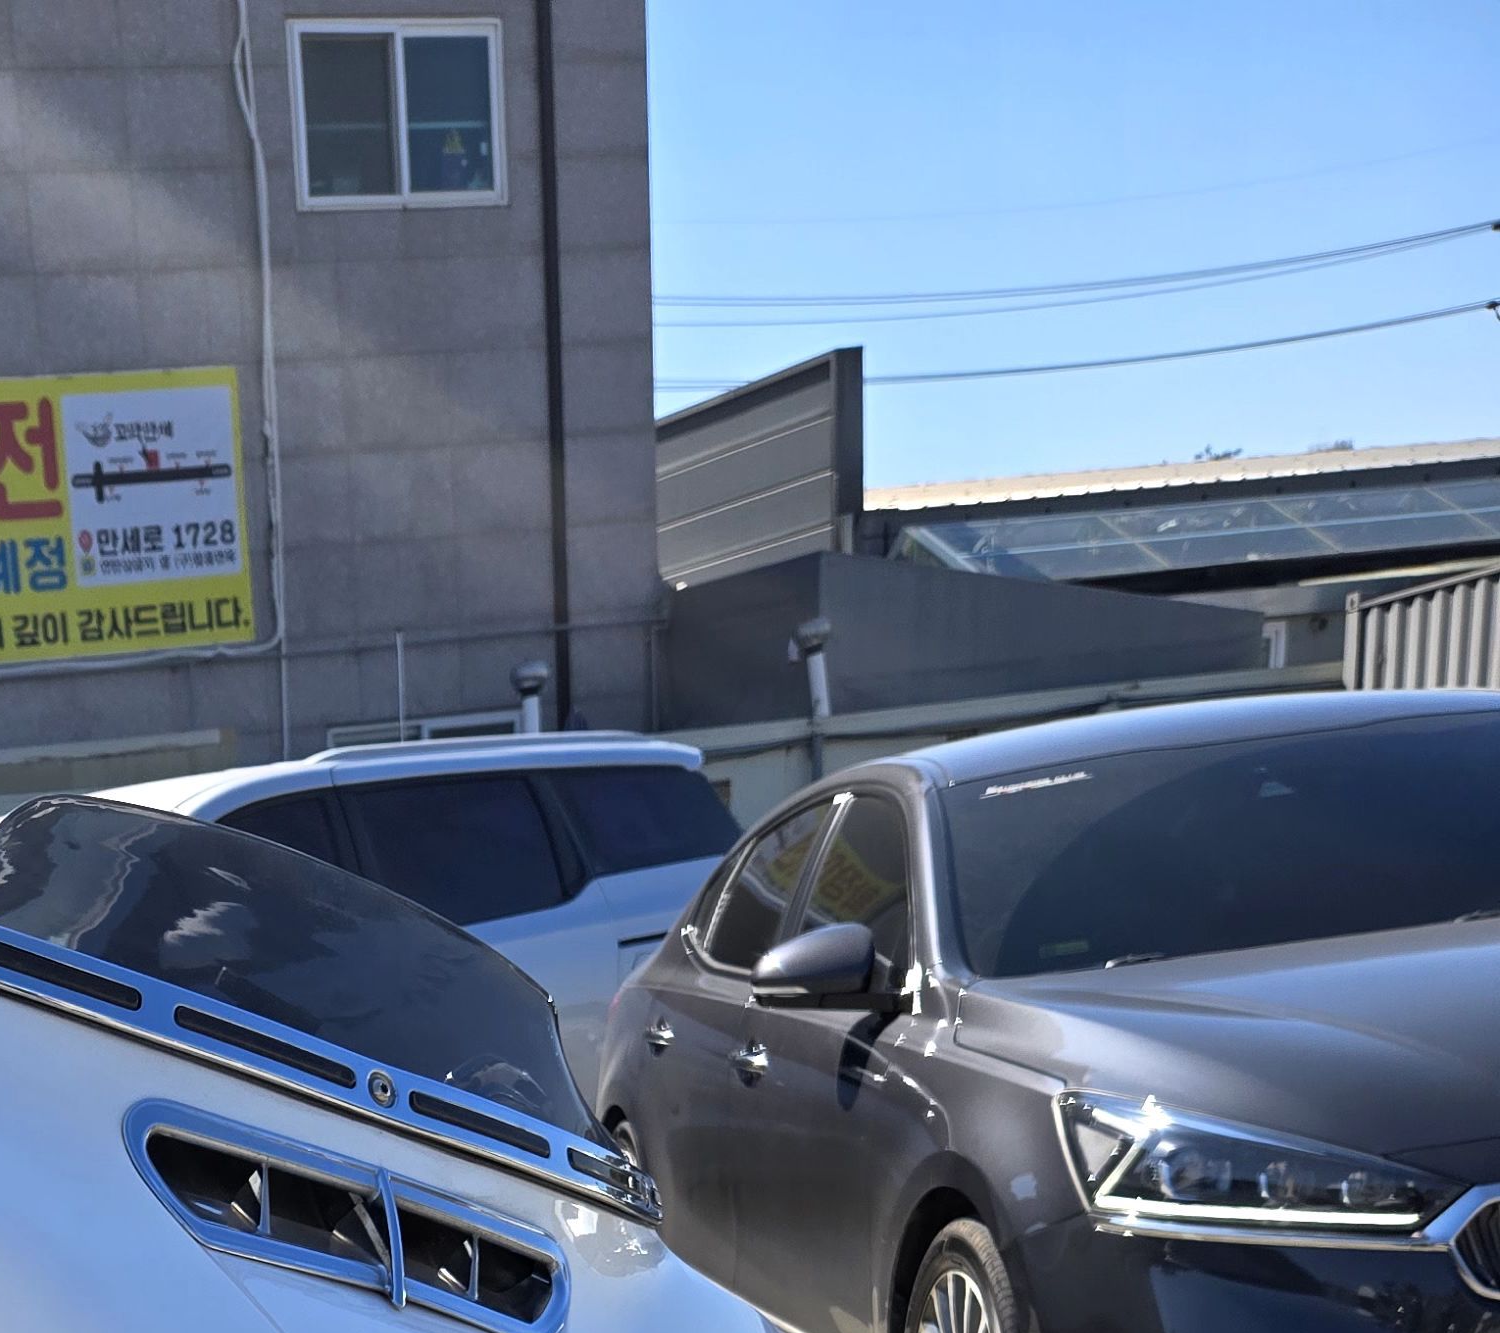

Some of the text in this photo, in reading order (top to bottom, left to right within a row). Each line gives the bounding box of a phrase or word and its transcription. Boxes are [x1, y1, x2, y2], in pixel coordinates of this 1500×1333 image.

[96, 519, 236, 556] 만세로 1728
[13, 612, 69, 648] 깊이
[77, 596, 250, 643] 감사드립니다.
